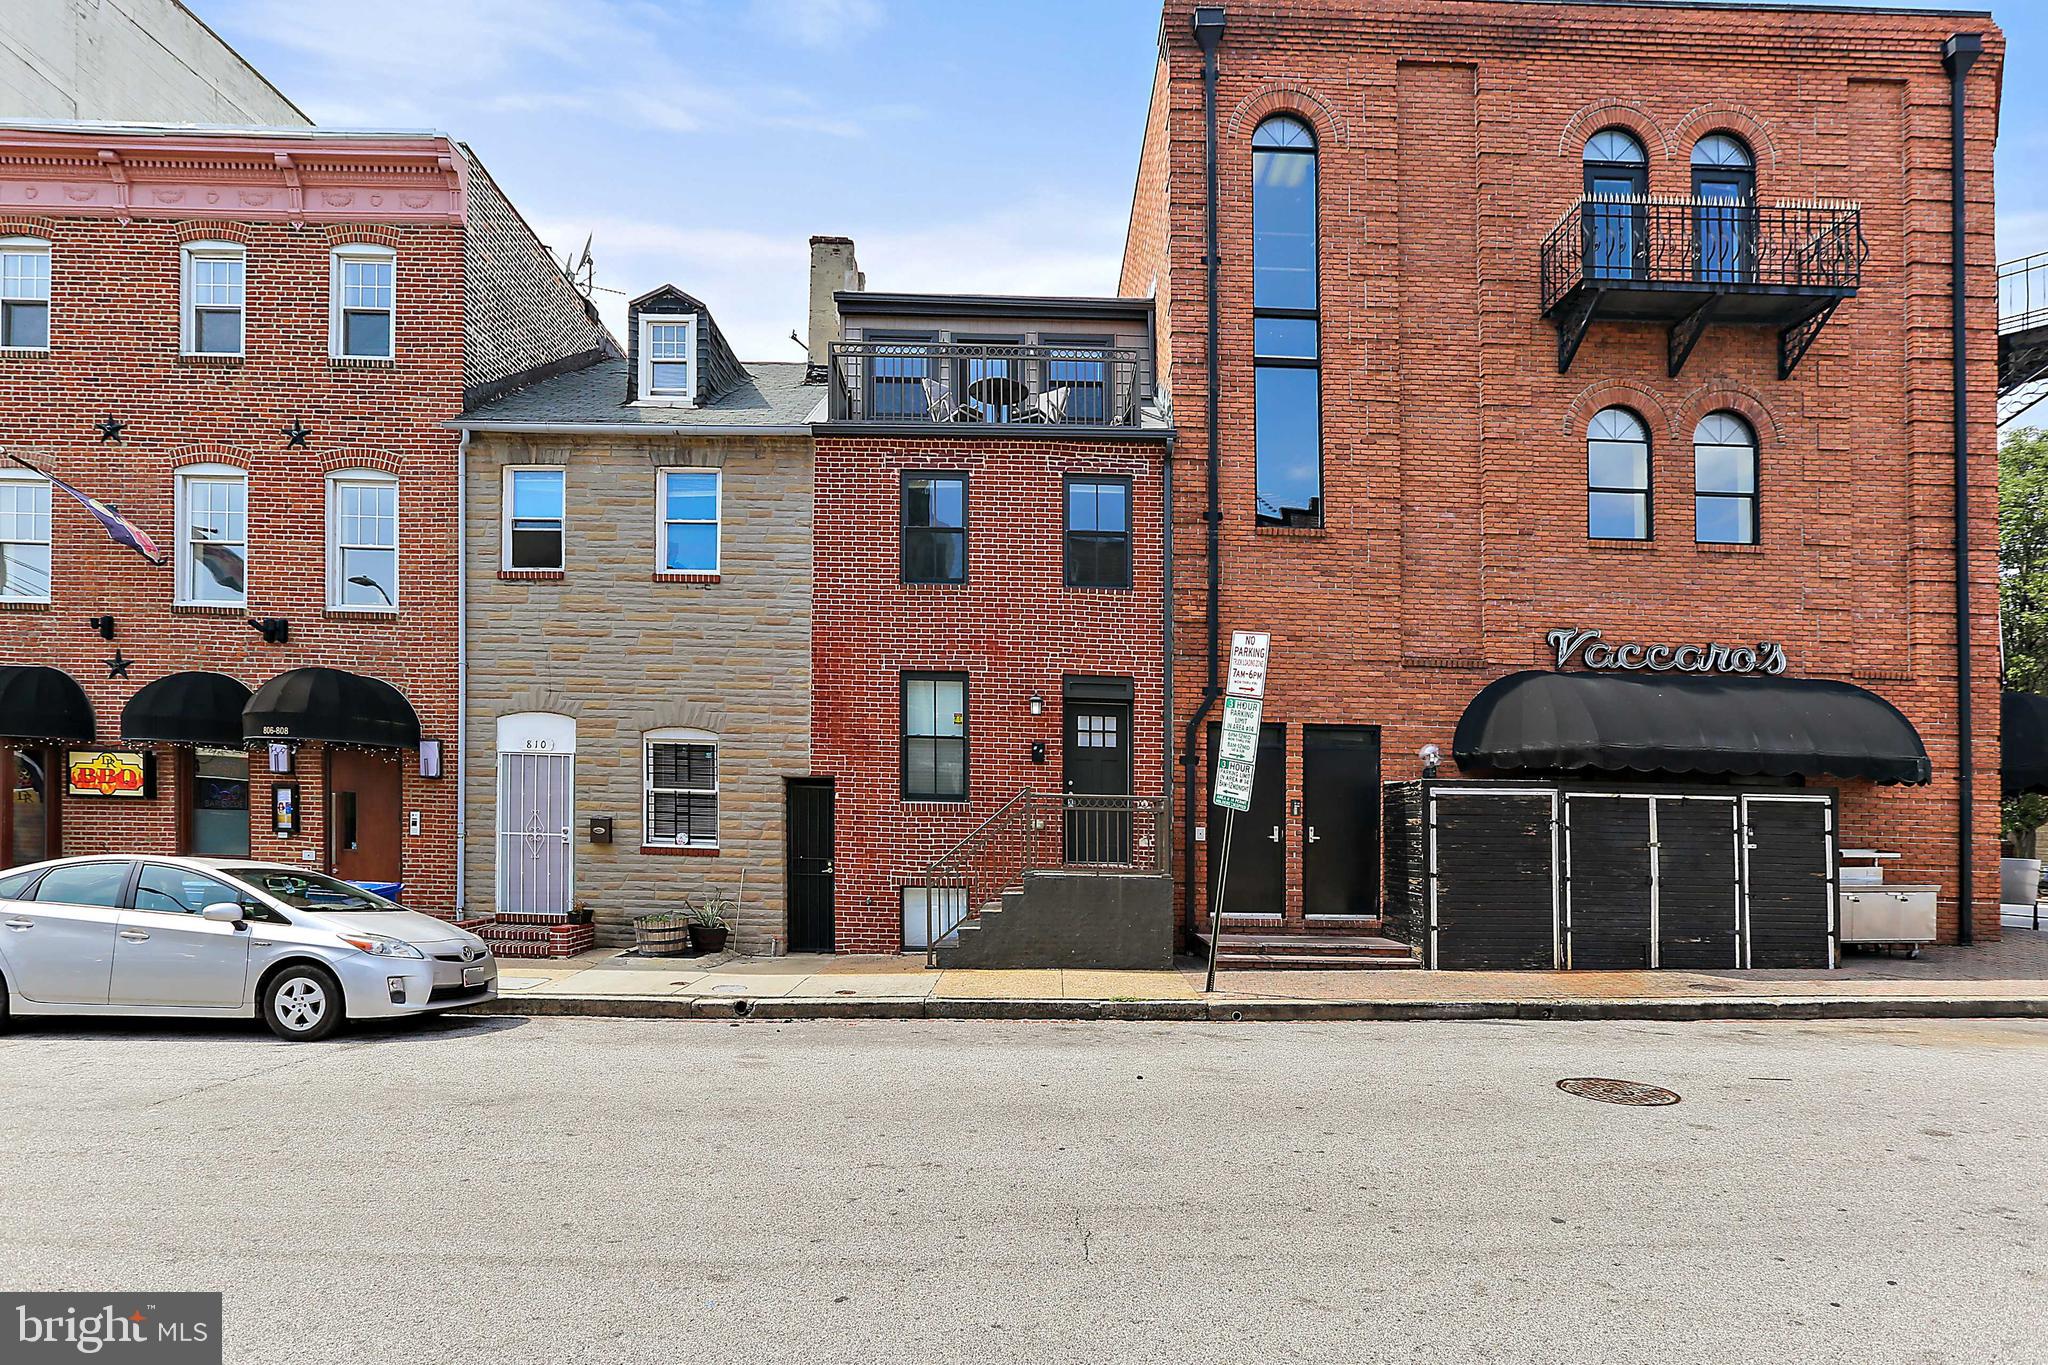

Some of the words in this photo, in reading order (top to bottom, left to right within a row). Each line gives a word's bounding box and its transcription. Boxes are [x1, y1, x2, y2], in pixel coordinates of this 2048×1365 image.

[1245, 636, 1256, 646] NO
[1234, 646, 1265, 658] PARKING
[1548, 627, 1787, 675] Vaccaro's
[1232, 668, 1262, 679] 7AM-6PM
[1236, 702, 1258, 711] HOUR
[1230, 709, 1254, 719] PARKING
[263, 726, 289, 735] 806-808
[526, 739, 547, 749] 810
[1230, 762, 1250, 773] HOUR
[77, 767, 138, 788] BBQ
[1220, 769, 1238, 777] PARKING
